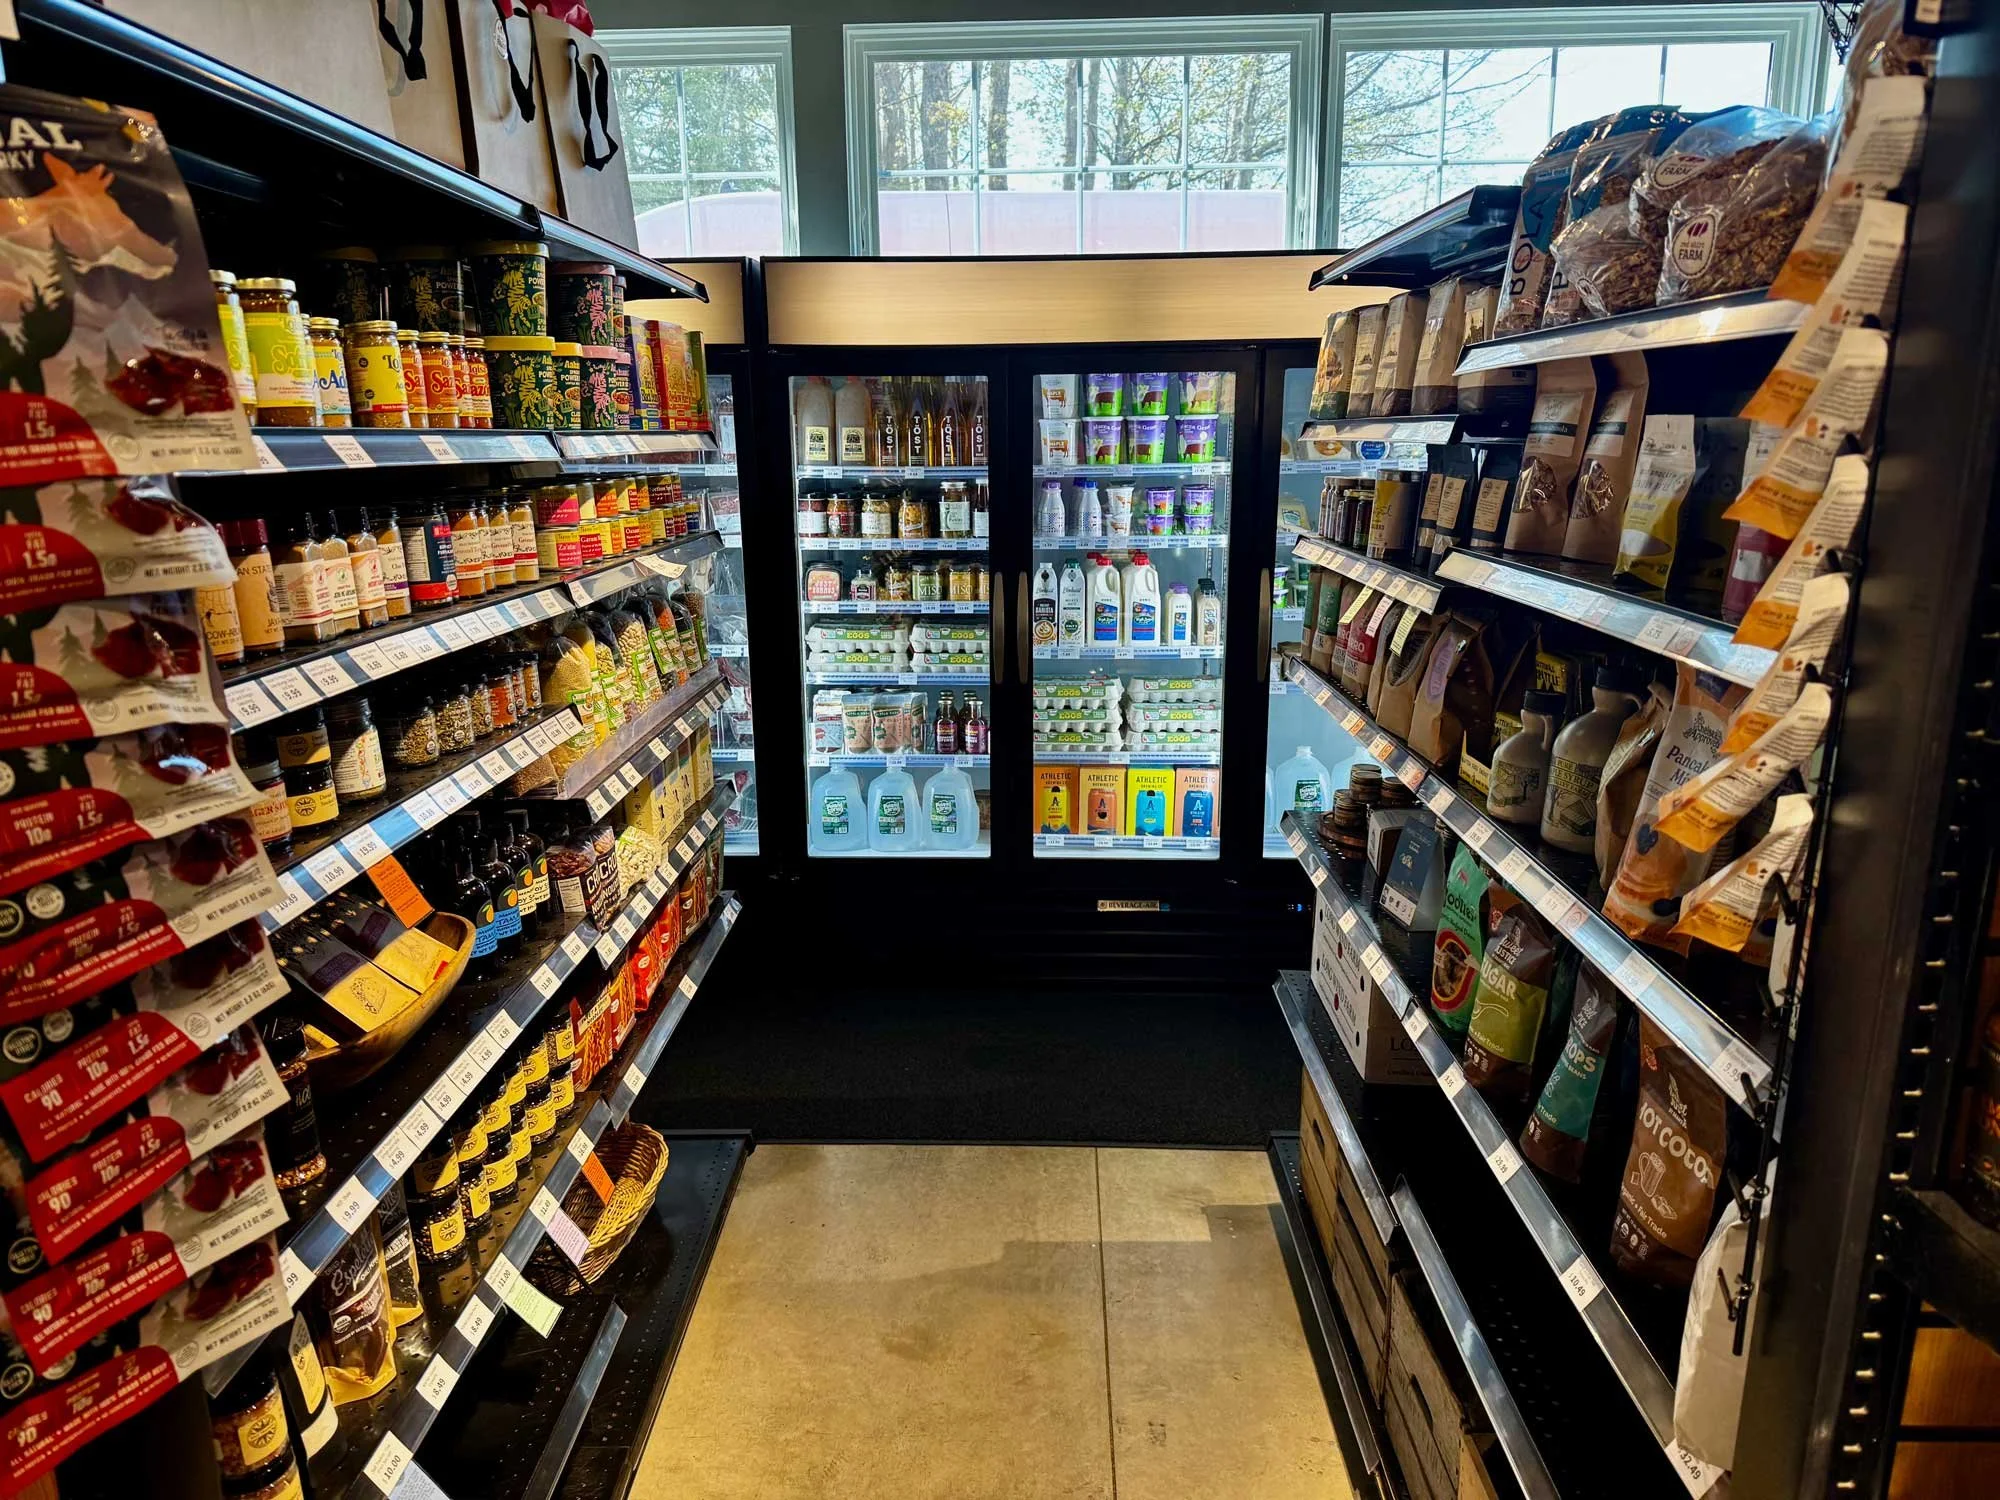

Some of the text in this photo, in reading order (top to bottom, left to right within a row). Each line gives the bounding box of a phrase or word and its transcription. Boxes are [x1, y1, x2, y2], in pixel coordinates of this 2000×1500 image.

[0, 117, 83, 151] AL
[1677, 248, 1703, 262] FARM
[1666, 744, 1710, 775] Pancak
[1040, 772, 1072, 780] ATHLETIC
[1088, 774, 1118, 782] ATHLETIC
[1136, 776, 1167, 784] ATHLETIC
[1184, 776, 1216, 784] ATHLETIC
[40, 1090, 64, 1111] 90
[48, 1192, 72, 1214] 90
